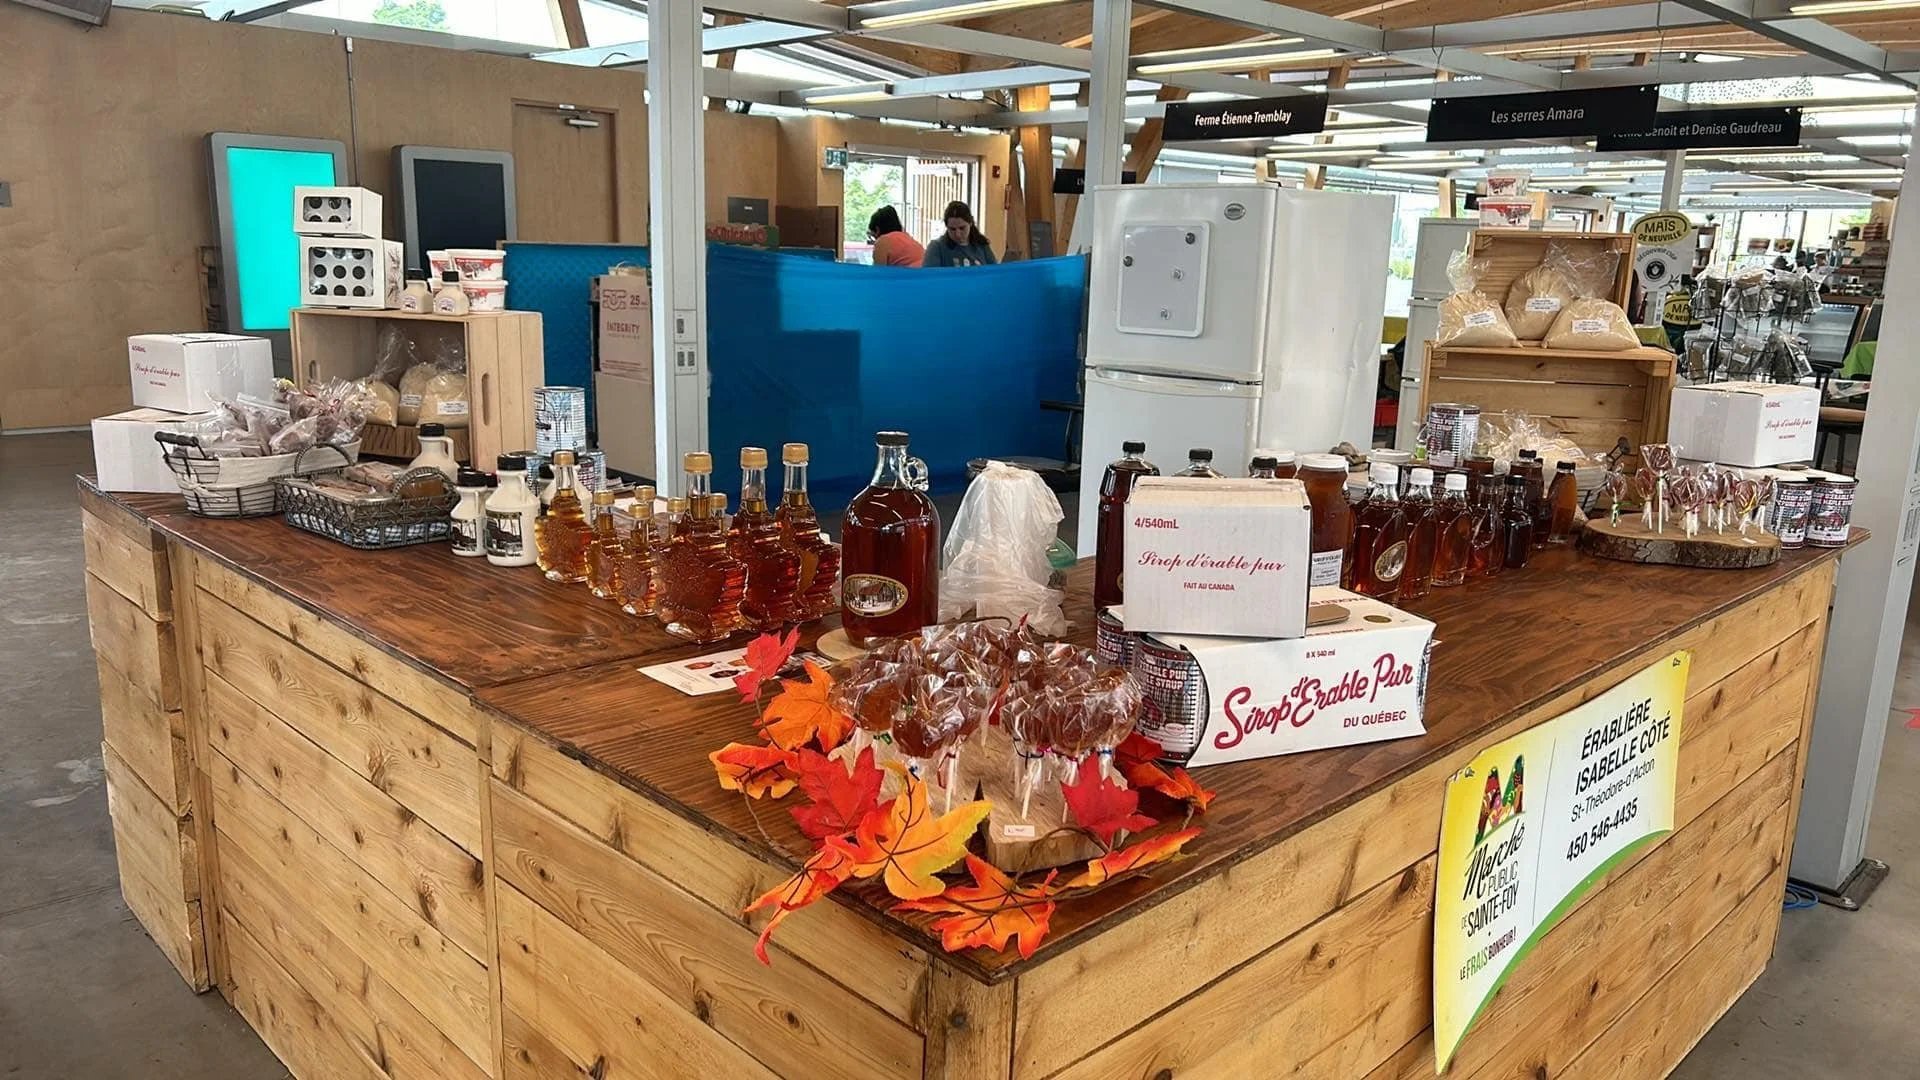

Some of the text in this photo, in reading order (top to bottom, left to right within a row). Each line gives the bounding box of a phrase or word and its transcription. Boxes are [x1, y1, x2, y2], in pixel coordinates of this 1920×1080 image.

[1194, 109, 1292, 126] Ferme Étienne Tremblay
[1491, 107, 1584, 123] Les serres Amara
[1679, 125, 1690, 136] et
[1691, 123, 1727, 136] Denise
[1729, 121, 1782, 135] Gaudreau
[1644, 219, 1676, 234] MAÏS
[1648, 231, 1682, 242] NEUVILLE
[630, 294, 640, 306] 25
[607, 320, 640, 334] INTEGRITY
[1134, 517, 1180, 530] 4/540mL
[1137, 550, 1287, 576] Sirop d'érable pur
[1183, 581, 1236, 591] FAIT AU CANADA
[1155, 677, 1184, 691] SYRUP
[1168, 669, 1188, 681] PUR
[1214, 686, 1292, 750] Sirop
[1370, 652, 1414, 704] Pur
[1343, 710, 1407, 729] DU QUÉBEC
[1581, 697, 1652, 761] ÉRABLIÈRE
[1575, 710, 1671, 796] ISABELLE CÔTÉ
[1571, 757, 1656, 823] St-Théodore-d'Acton
[1566, 797, 1639, 863] 450 546-4435
[1463, 817, 1526, 902] Marché
[1487, 860, 1519, 898] PUBLIC
[1467, 879, 1520, 939] SAINTE-FOY
[1460, 965, 1467, 981] LE
[1466, 945, 1489, 980] FRAIS
